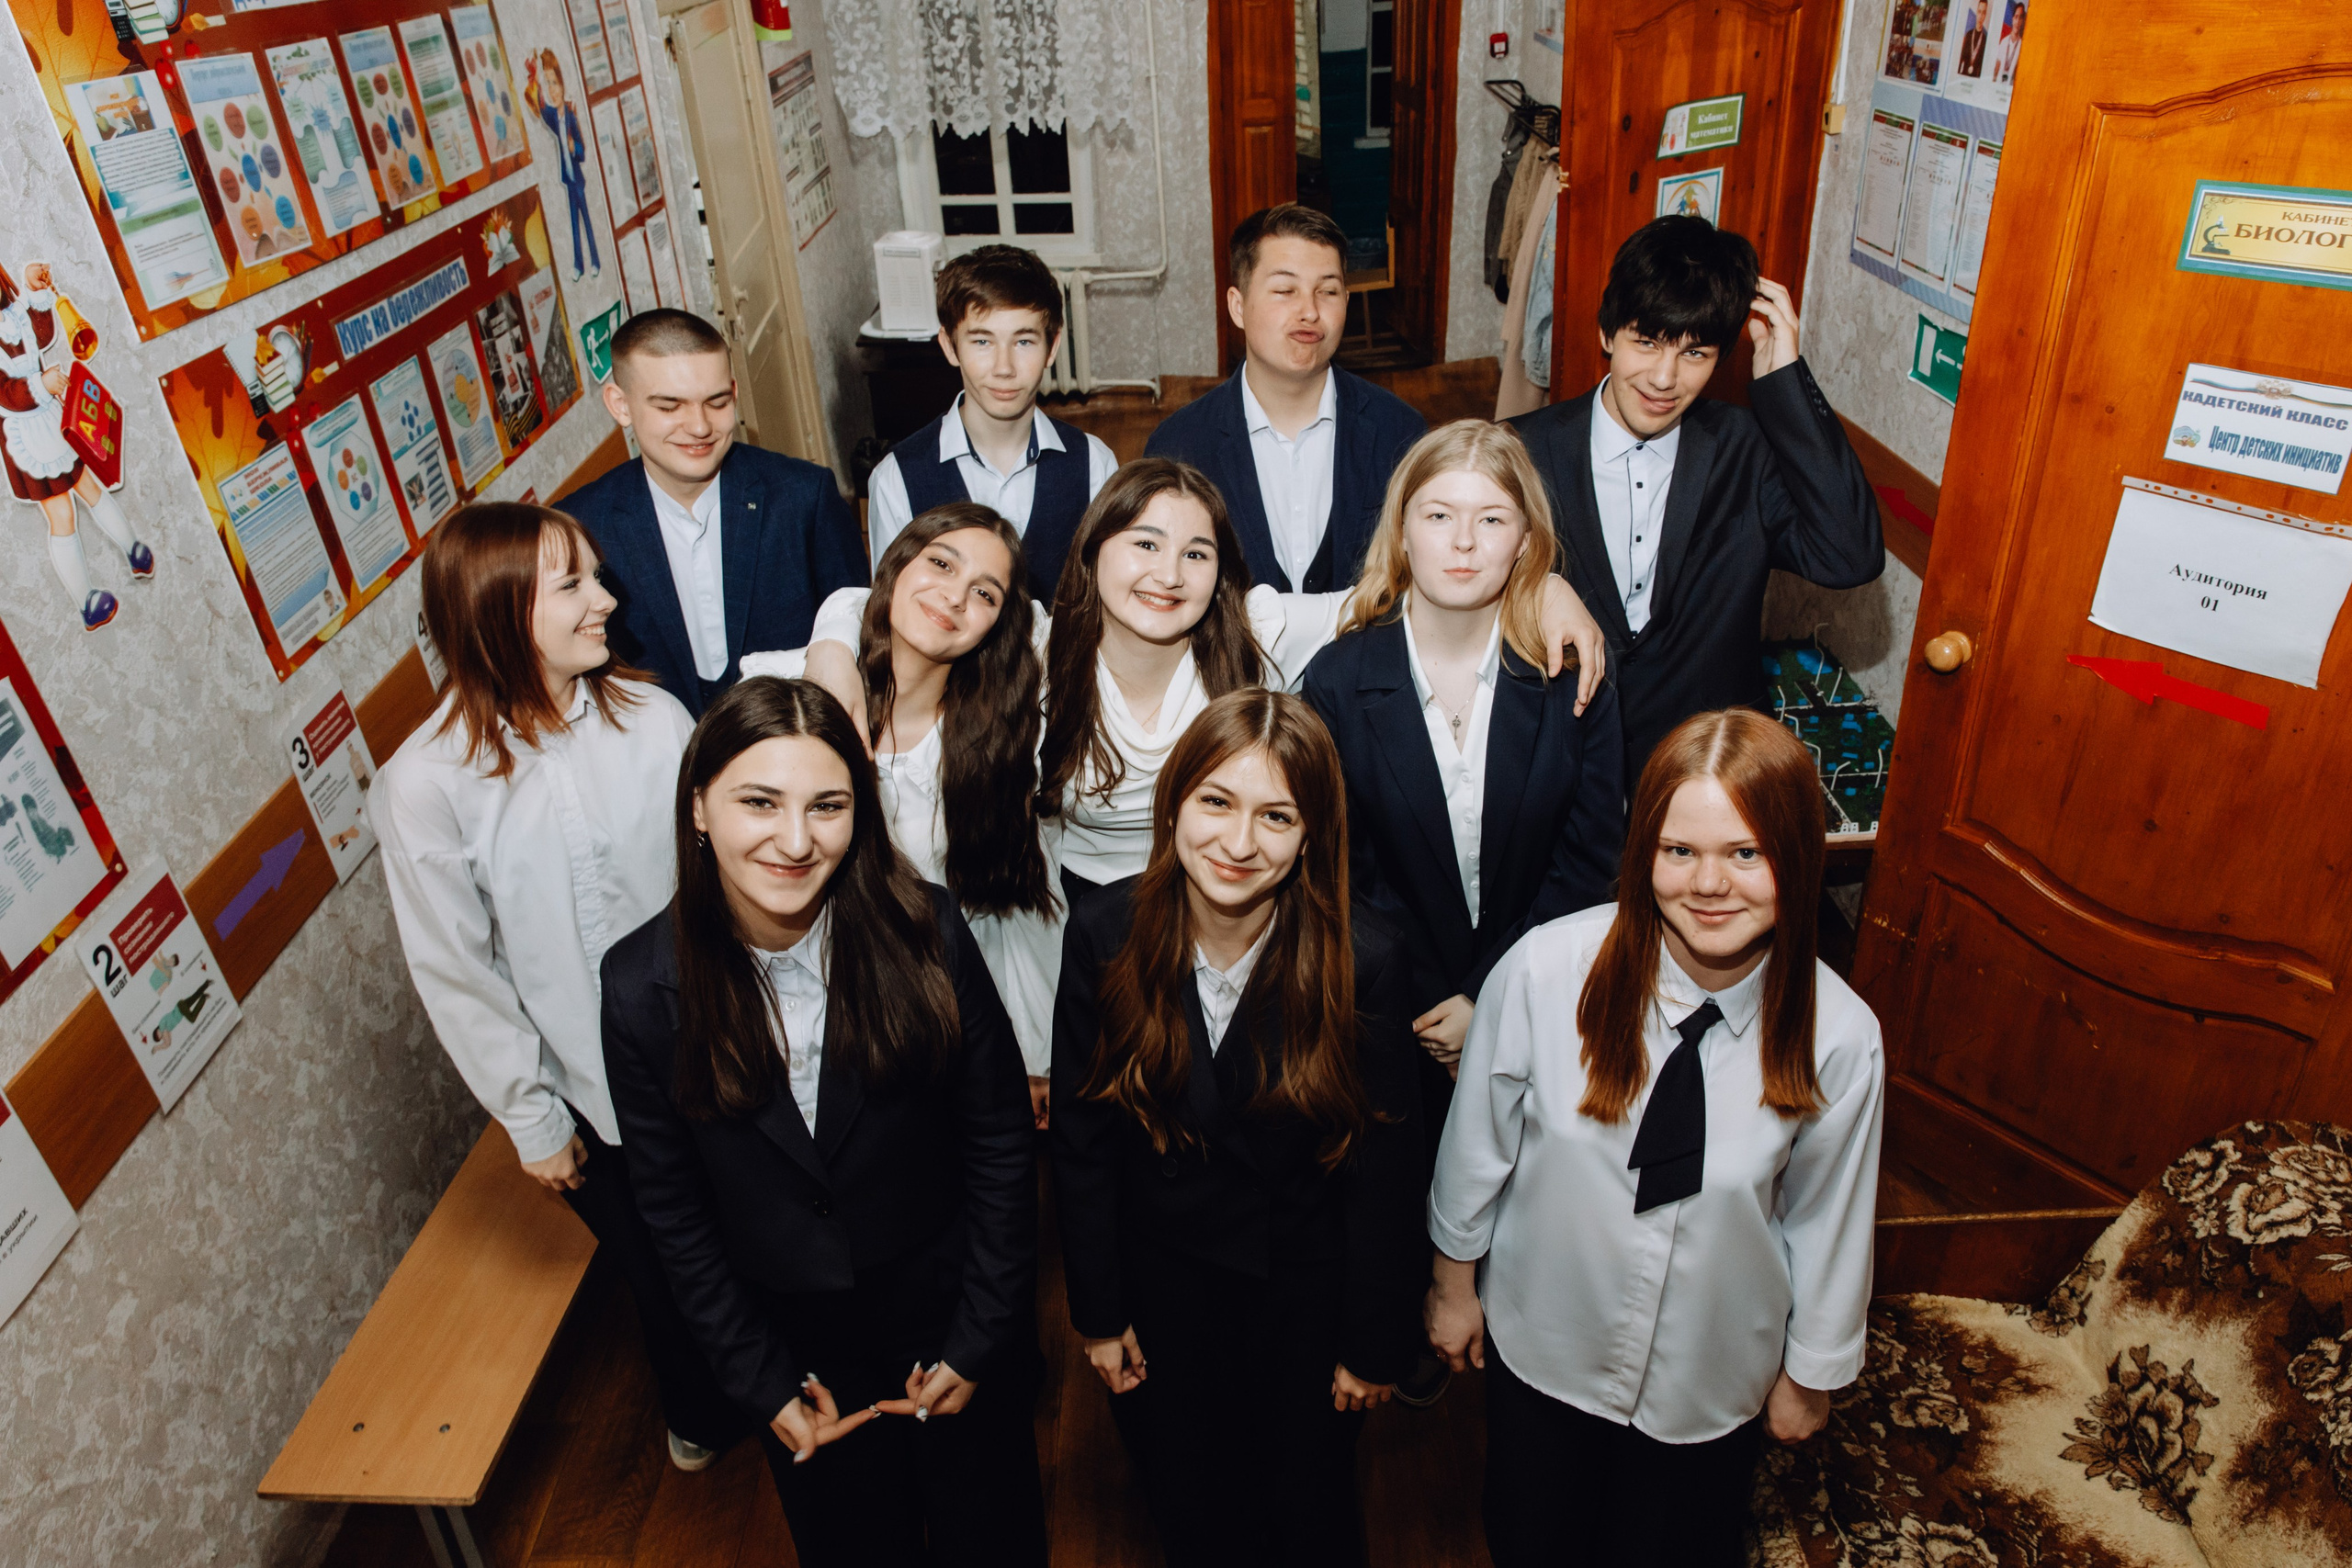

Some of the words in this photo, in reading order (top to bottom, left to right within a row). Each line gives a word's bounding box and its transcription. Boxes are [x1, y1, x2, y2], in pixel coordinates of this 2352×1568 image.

[1690, 125, 1734, 139] математики
[1698, 112, 1728, 125] Кабинет
[336, 313, 374, 355] Курс
[370, 305, 390, 338] на
[387, 261, 469, 329] бережливость
[78, 378, 101, 443] АБВ
[2182, 390, 2283, 419] КАДЕТСКИЙ
[2286, 410, 2349, 431] КЛАСС
[2208, 425, 2241, 456] Центр
[2237, 435, 2283, 464] детских
[2281, 443, 2343, 475] инициатив
[2169, 563, 2268, 600] Аудитория
[2200, 595, 2220, 612] 01
[291, 736, 310, 769] 3
[118, 907, 154, 945] Проверить
[92, 943, 122, 987] 2
[109, 973, 130, 998] шаг
